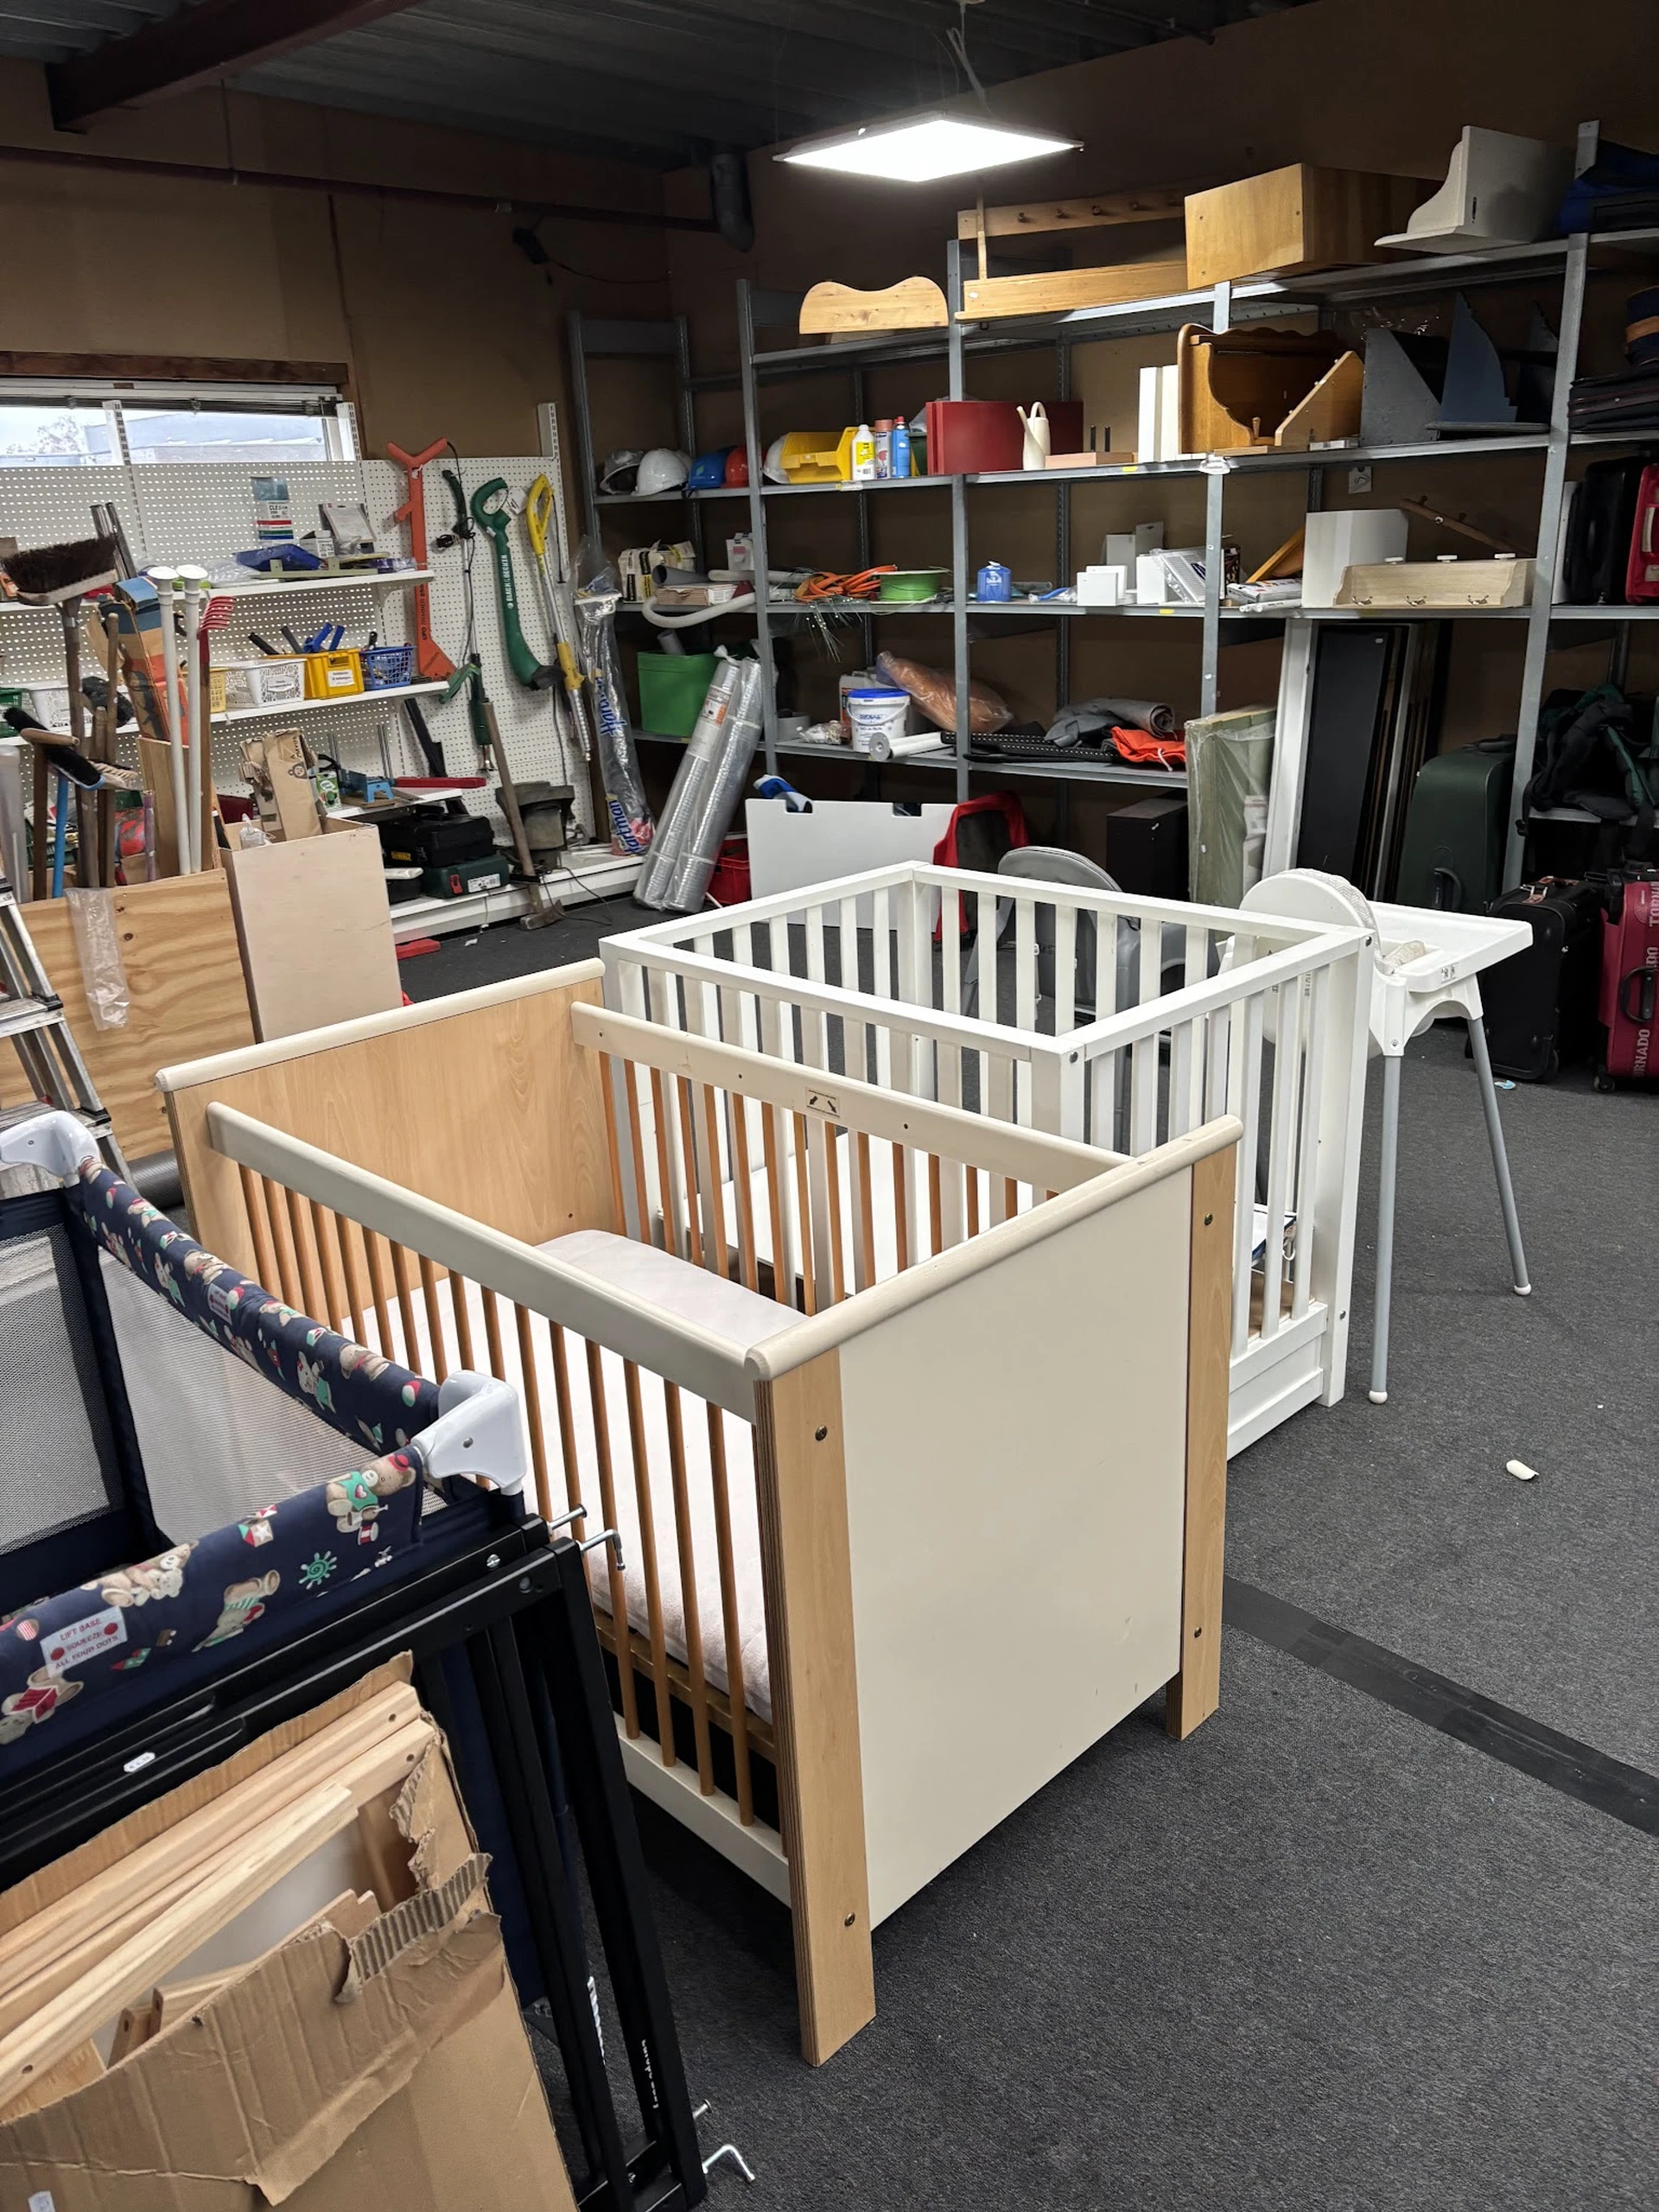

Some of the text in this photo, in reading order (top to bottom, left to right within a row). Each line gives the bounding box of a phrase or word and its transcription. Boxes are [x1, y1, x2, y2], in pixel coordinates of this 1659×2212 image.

[60, 1618, 102, 1641] LIFT BASE
[54, 1636, 118, 1669] ALL FOUR DOTS
